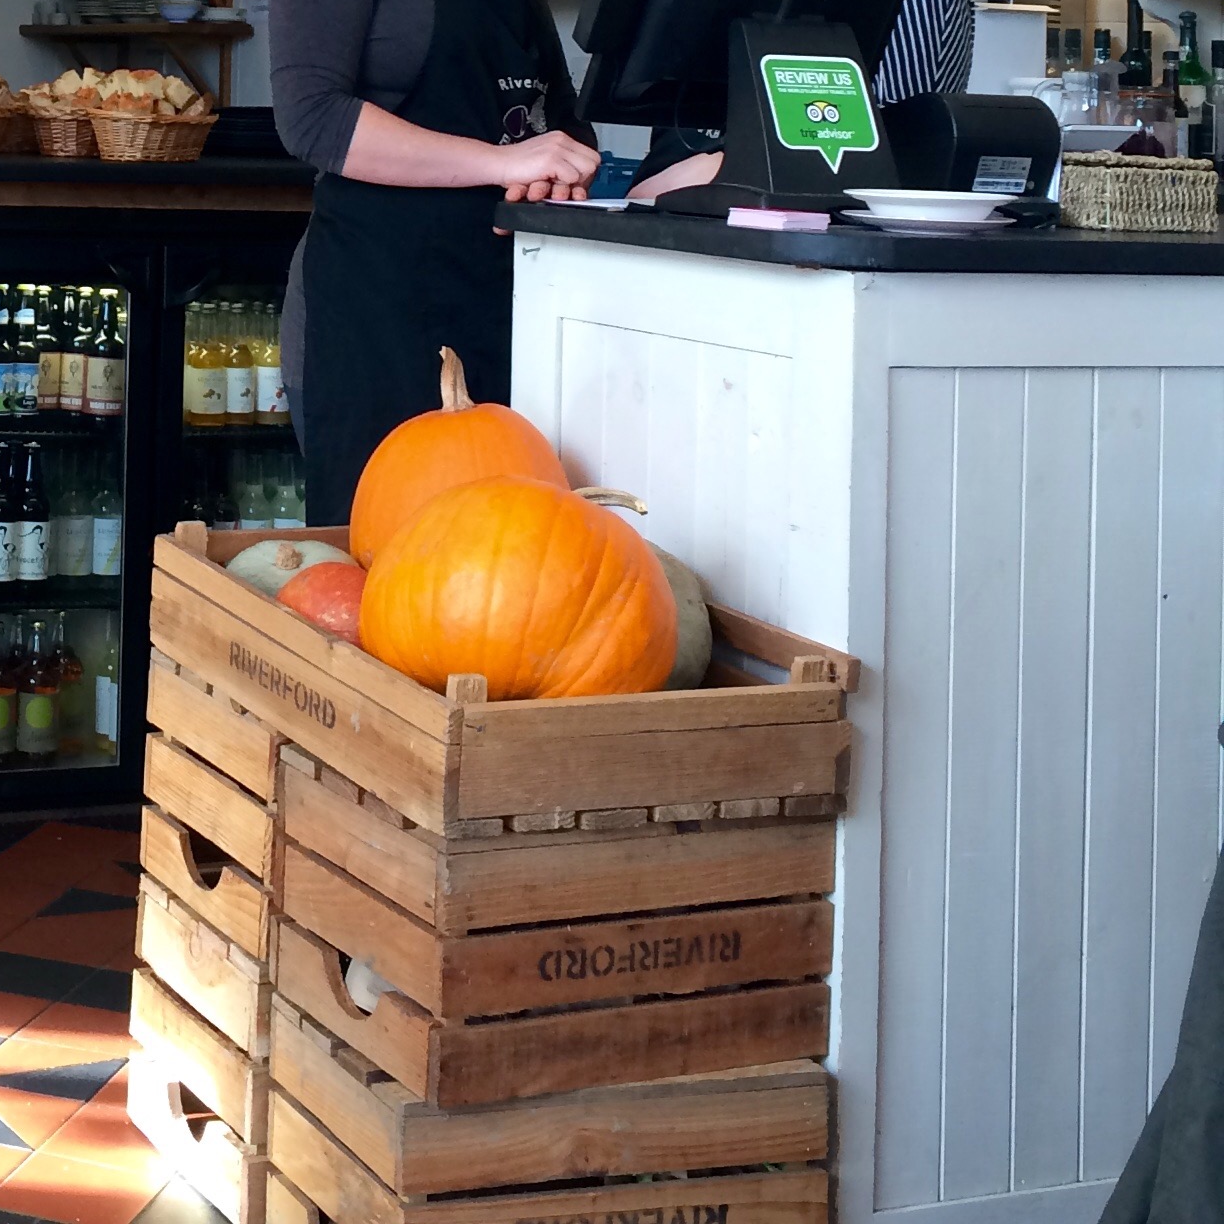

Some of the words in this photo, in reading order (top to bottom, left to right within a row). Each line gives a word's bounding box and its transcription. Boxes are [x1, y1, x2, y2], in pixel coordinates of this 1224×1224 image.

[774, 70, 829, 85] REVIEW
[832, 73, 853, 86] US
[800, 127, 855, 140] tripadvisor
[229, 640, 337, 730] RIVERFORD
[537, 930, 742, 982] RIVERFORD
